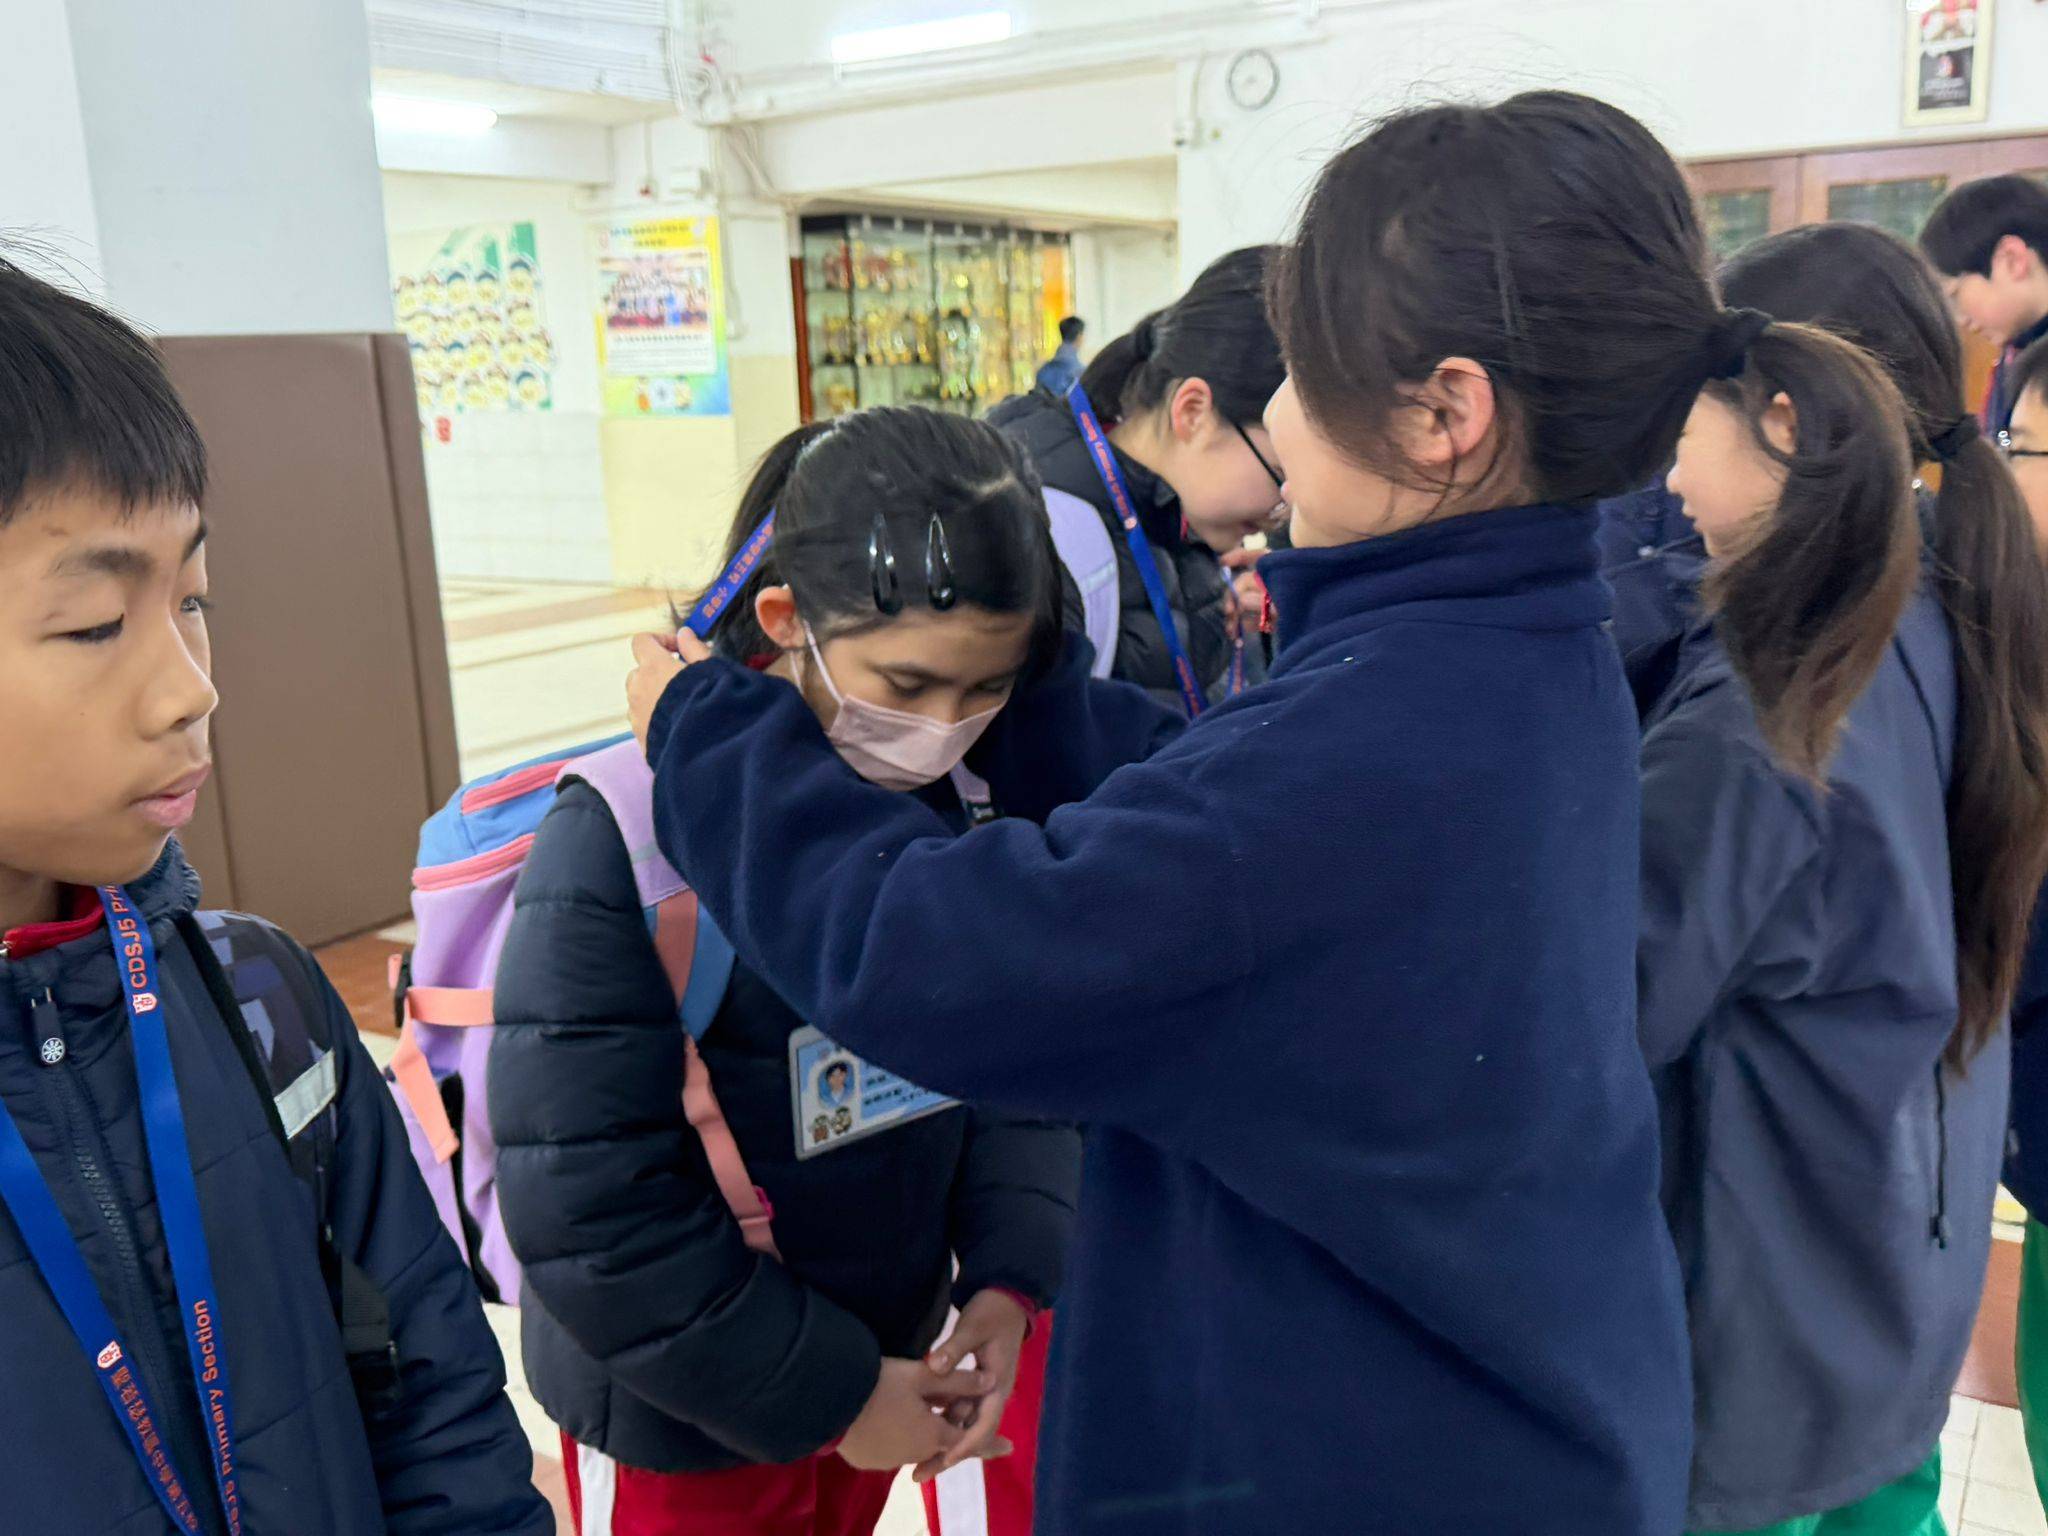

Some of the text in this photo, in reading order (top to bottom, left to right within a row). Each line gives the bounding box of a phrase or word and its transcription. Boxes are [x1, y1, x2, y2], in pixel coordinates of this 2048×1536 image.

[118, 918, 147, 989] CDSJ5
[193, 1299, 219, 1383] Section
[209, 1389, 232, 1476] Primary
